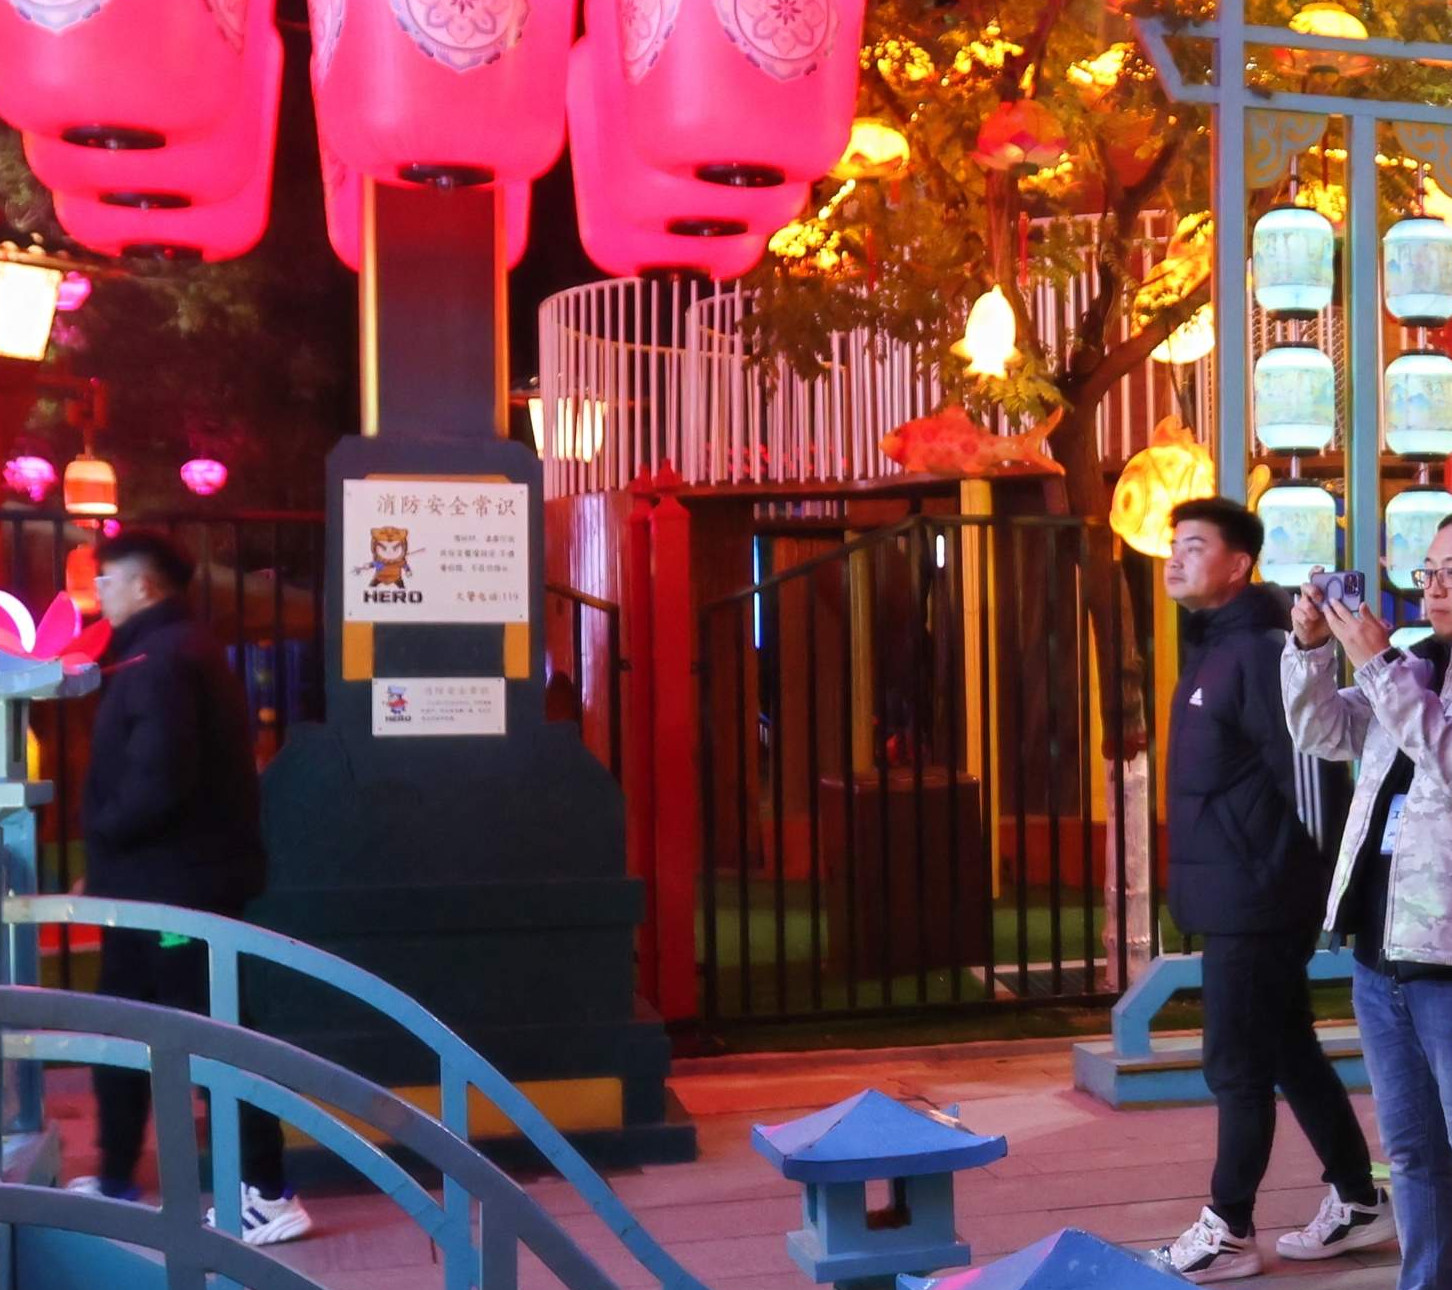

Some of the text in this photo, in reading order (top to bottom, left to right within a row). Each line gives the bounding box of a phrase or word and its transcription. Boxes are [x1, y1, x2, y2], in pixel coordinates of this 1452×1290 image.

[377, 494, 517, 517] 消防安全常识
[363, 590, 423, 604] HERO
